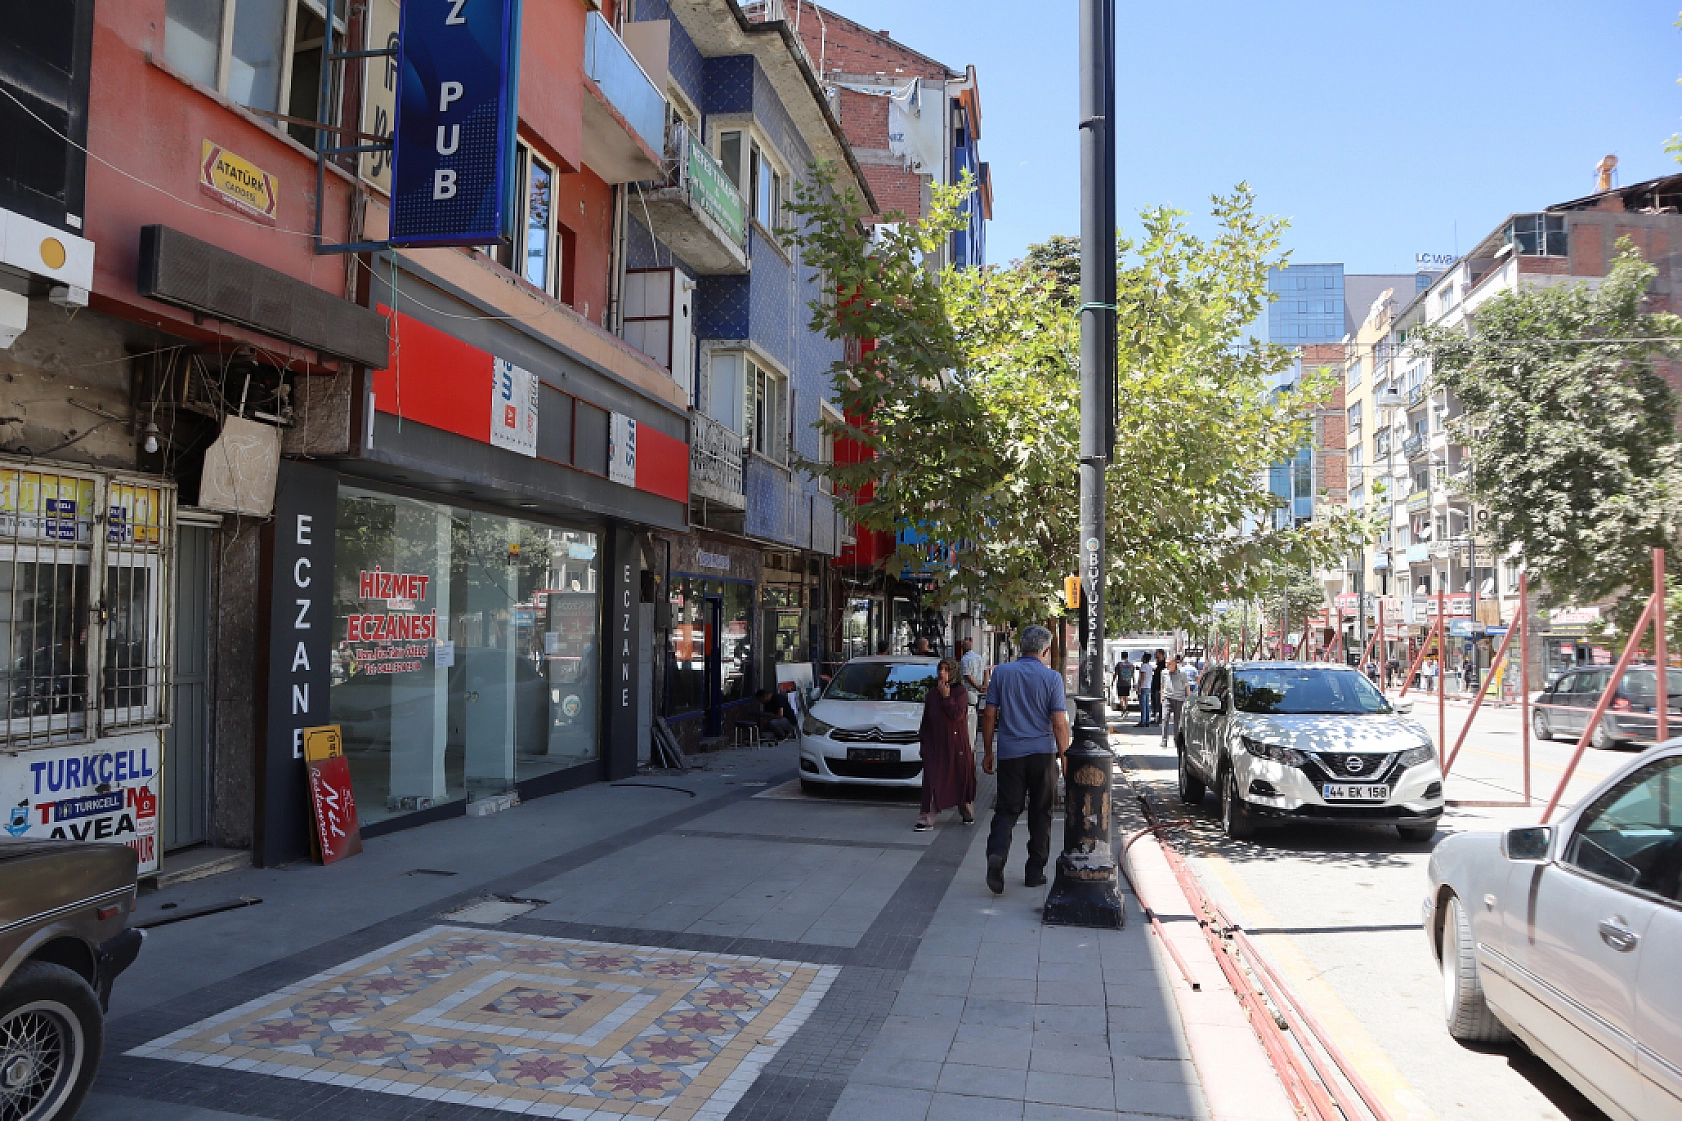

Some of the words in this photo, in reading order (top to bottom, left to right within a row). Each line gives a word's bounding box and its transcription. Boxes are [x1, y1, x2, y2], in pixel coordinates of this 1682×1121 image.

[432, 82, 465, 201] PUB
[216, 160, 264, 194] ATATÜRK
[360, 566, 429, 600] HİZMET
[291, 514, 313, 759] ECZANE
[347, 608, 437, 642] ECZANESİ
[622, 564, 631, 707] ECZANE
[30, 748, 153, 795] TURKCELL
[74, 796, 120, 813] TURKCELL
[1348, 787, 1362, 797] EK
[50, 813, 135, 841] AVEA
